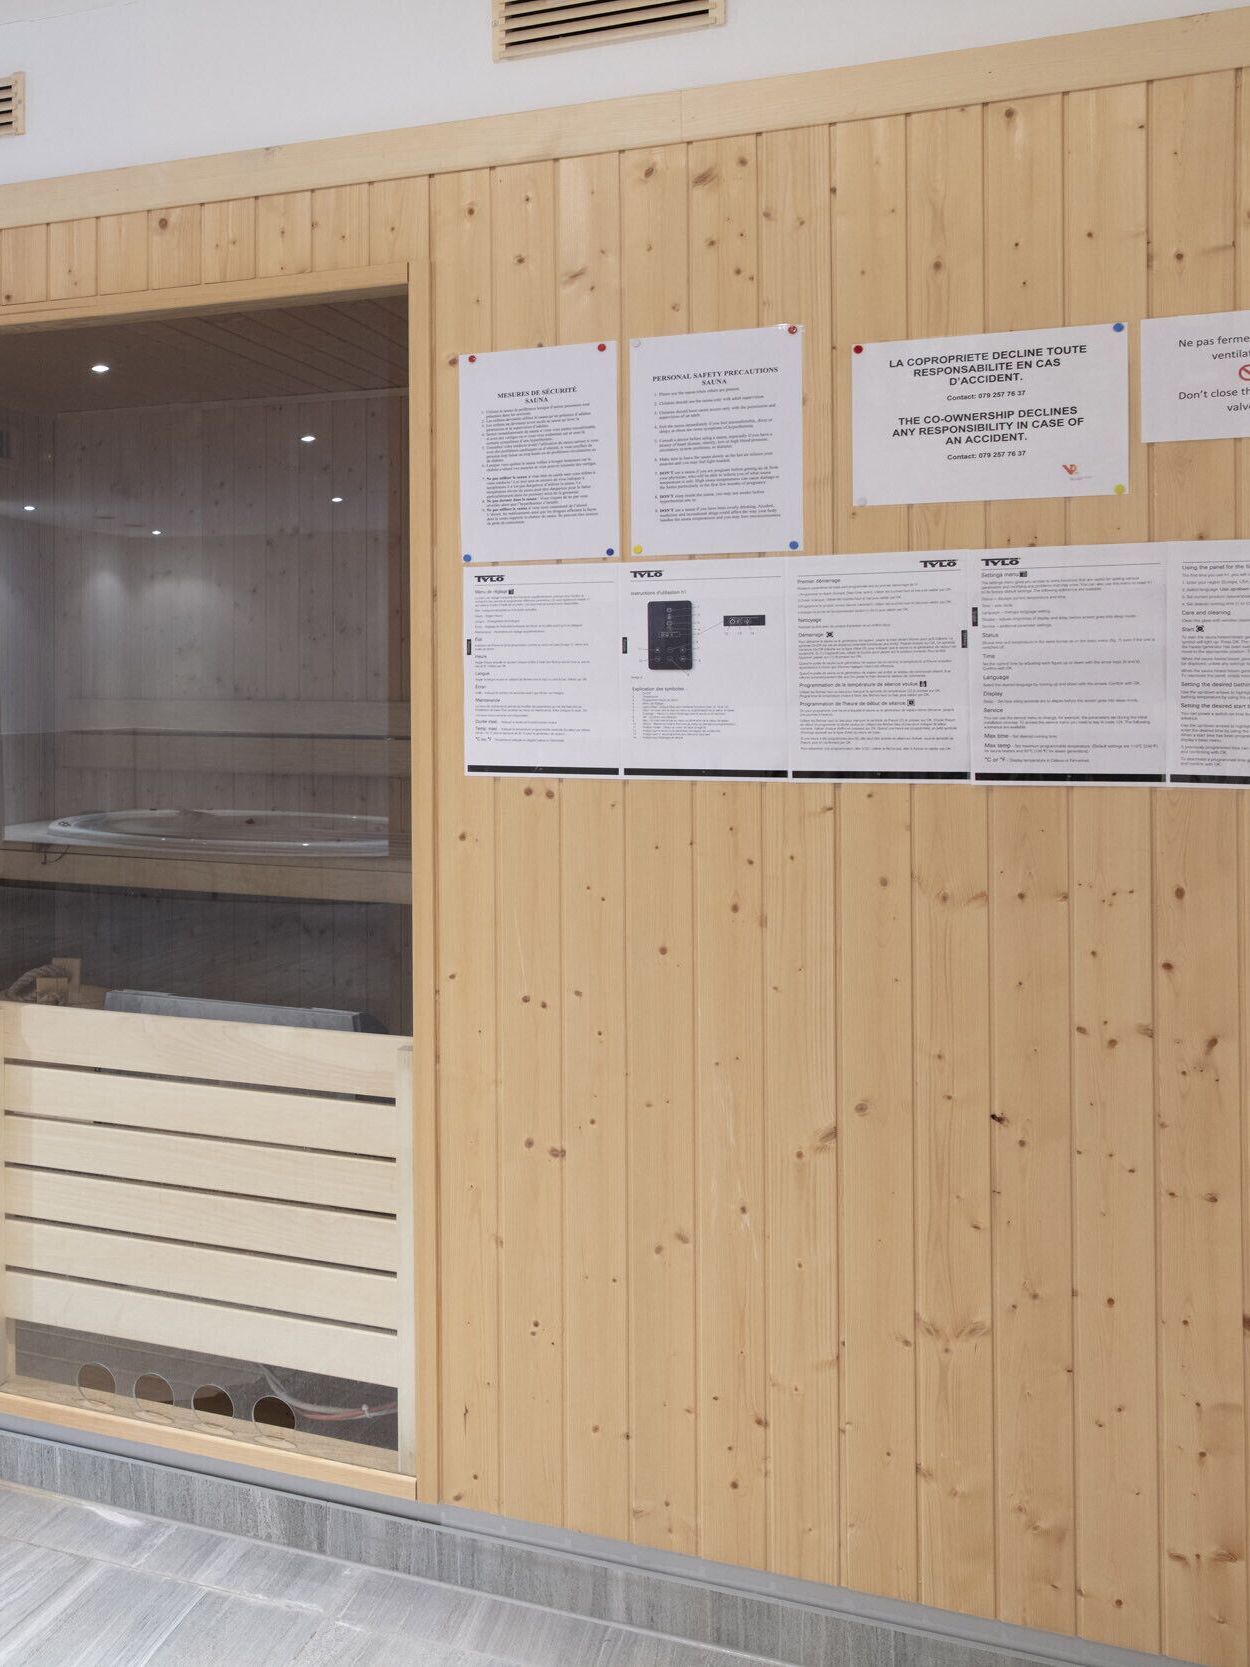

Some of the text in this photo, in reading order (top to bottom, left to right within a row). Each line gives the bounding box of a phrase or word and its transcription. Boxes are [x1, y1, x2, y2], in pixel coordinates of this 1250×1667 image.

[1196, 338, 1214, 348] pas
[889, 345, 1087, 368] LA COPROPRIETE DECLINE TOUTE
[652, 367, 779, 382] PERSONAL SAFETY PRECAUTIONS
[913, 358, 1061, 377] RESPONSABILITE EN CAS
[949, 373, 1023, 386] D'ACCIDENT.
[497, 391, 530, 399] MESURES
[542, 386, 577, 395] SÉCURITÉ
[1179, 390, 1208, 400] Don't
[1211, 389, 1238, 398] close
[898, 406, 1078, 425] THE CO-OWNERSHIP DECLINES
[892, 417, 1084, 437] ANY RESPONSIBILITY IN CASE OF
[945, 432, 1027, 445] AN ACCIDENT.
